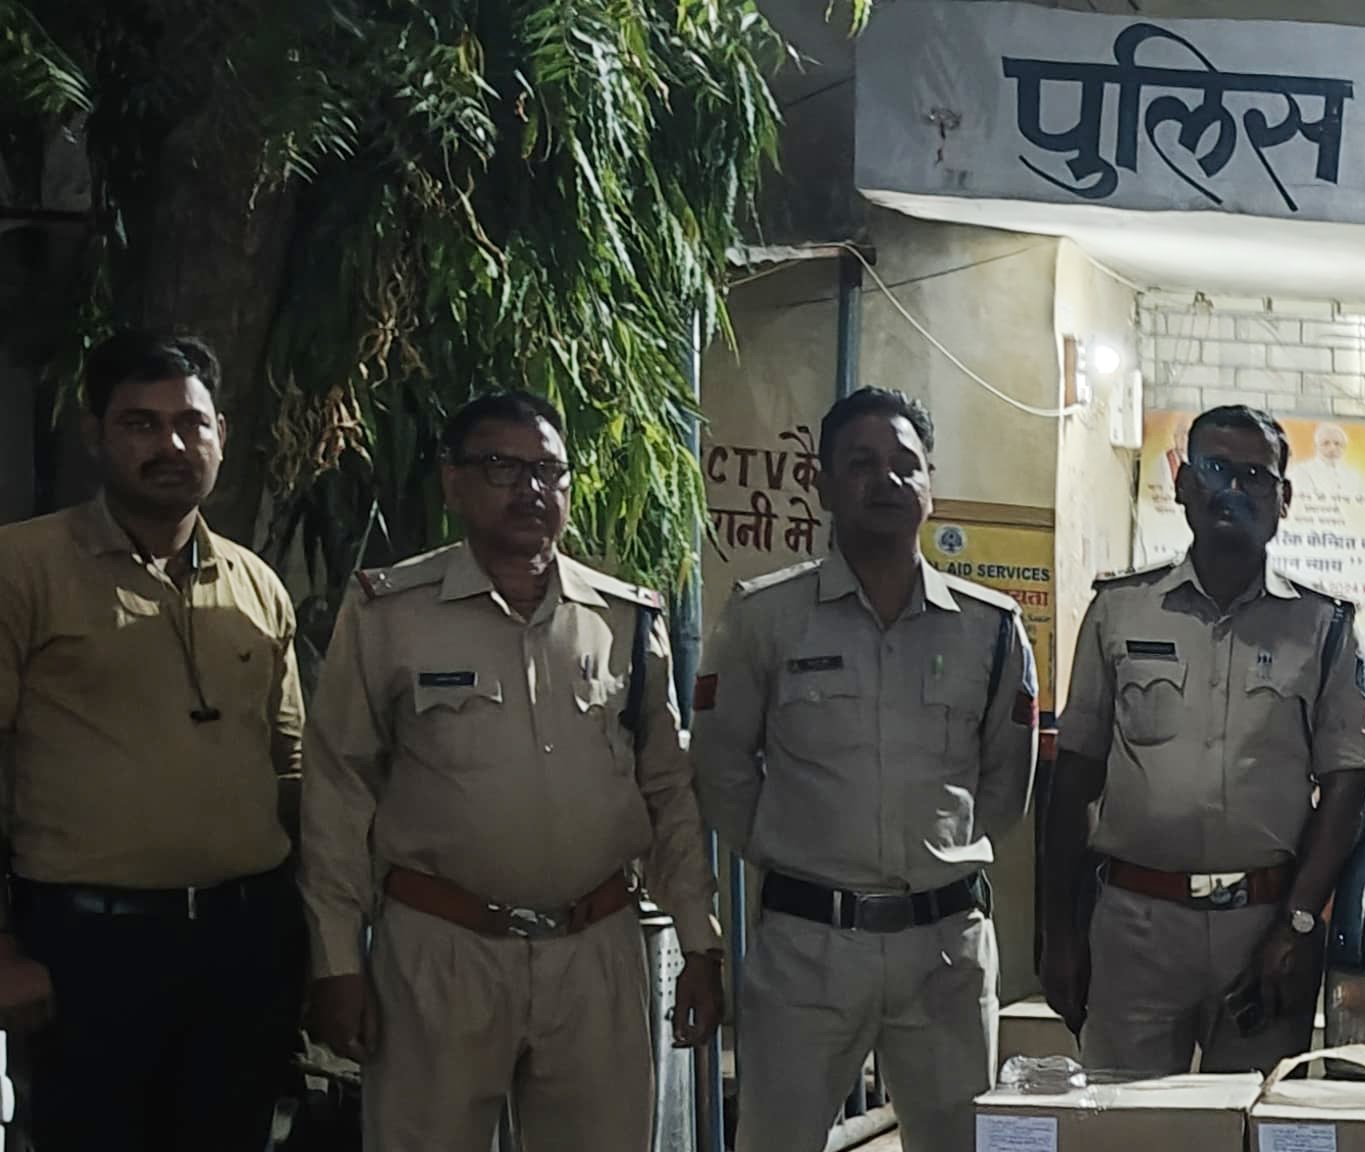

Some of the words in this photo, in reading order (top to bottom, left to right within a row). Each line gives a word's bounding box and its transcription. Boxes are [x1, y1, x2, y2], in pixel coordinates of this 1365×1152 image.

[1001, 22, 1354, 212] पुलिस
[707, 446, 787, 490] CTV
[779, 426, 820, 493] कै
[706, 491, 778, 562] रानी
[947, 562, 972, 577] AID
[977, 564, 1050, 582] SERVICES
